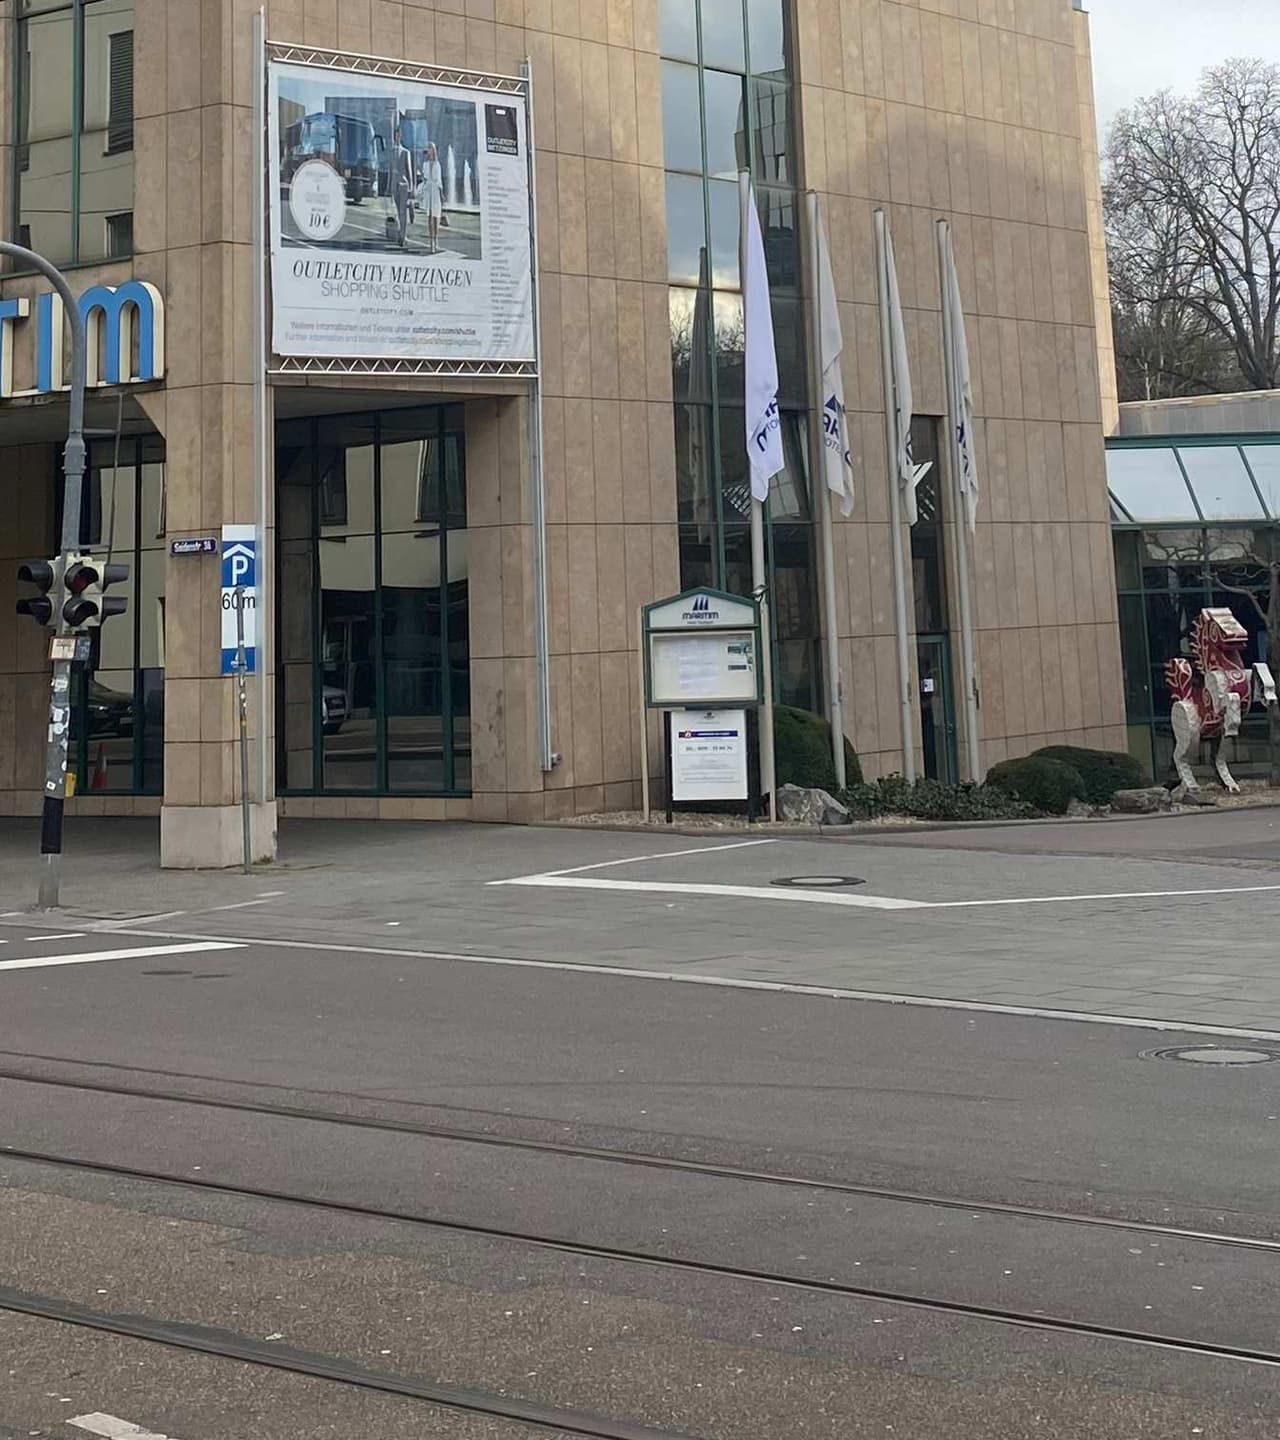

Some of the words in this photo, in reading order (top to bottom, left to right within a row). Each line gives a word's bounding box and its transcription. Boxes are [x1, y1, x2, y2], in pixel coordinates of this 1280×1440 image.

[309, 212, 322, 228] 10
[293, 259, 385, 281] OUTLETCITY
[391, 265, 473, 287] METZINGEN
[321, 280, 388, 301] SHOPPING
[392, 284, 449, 303] SHUTTLE
[232, 556, 249, 586] P
[682, 612, 719, 620] MARITIM
